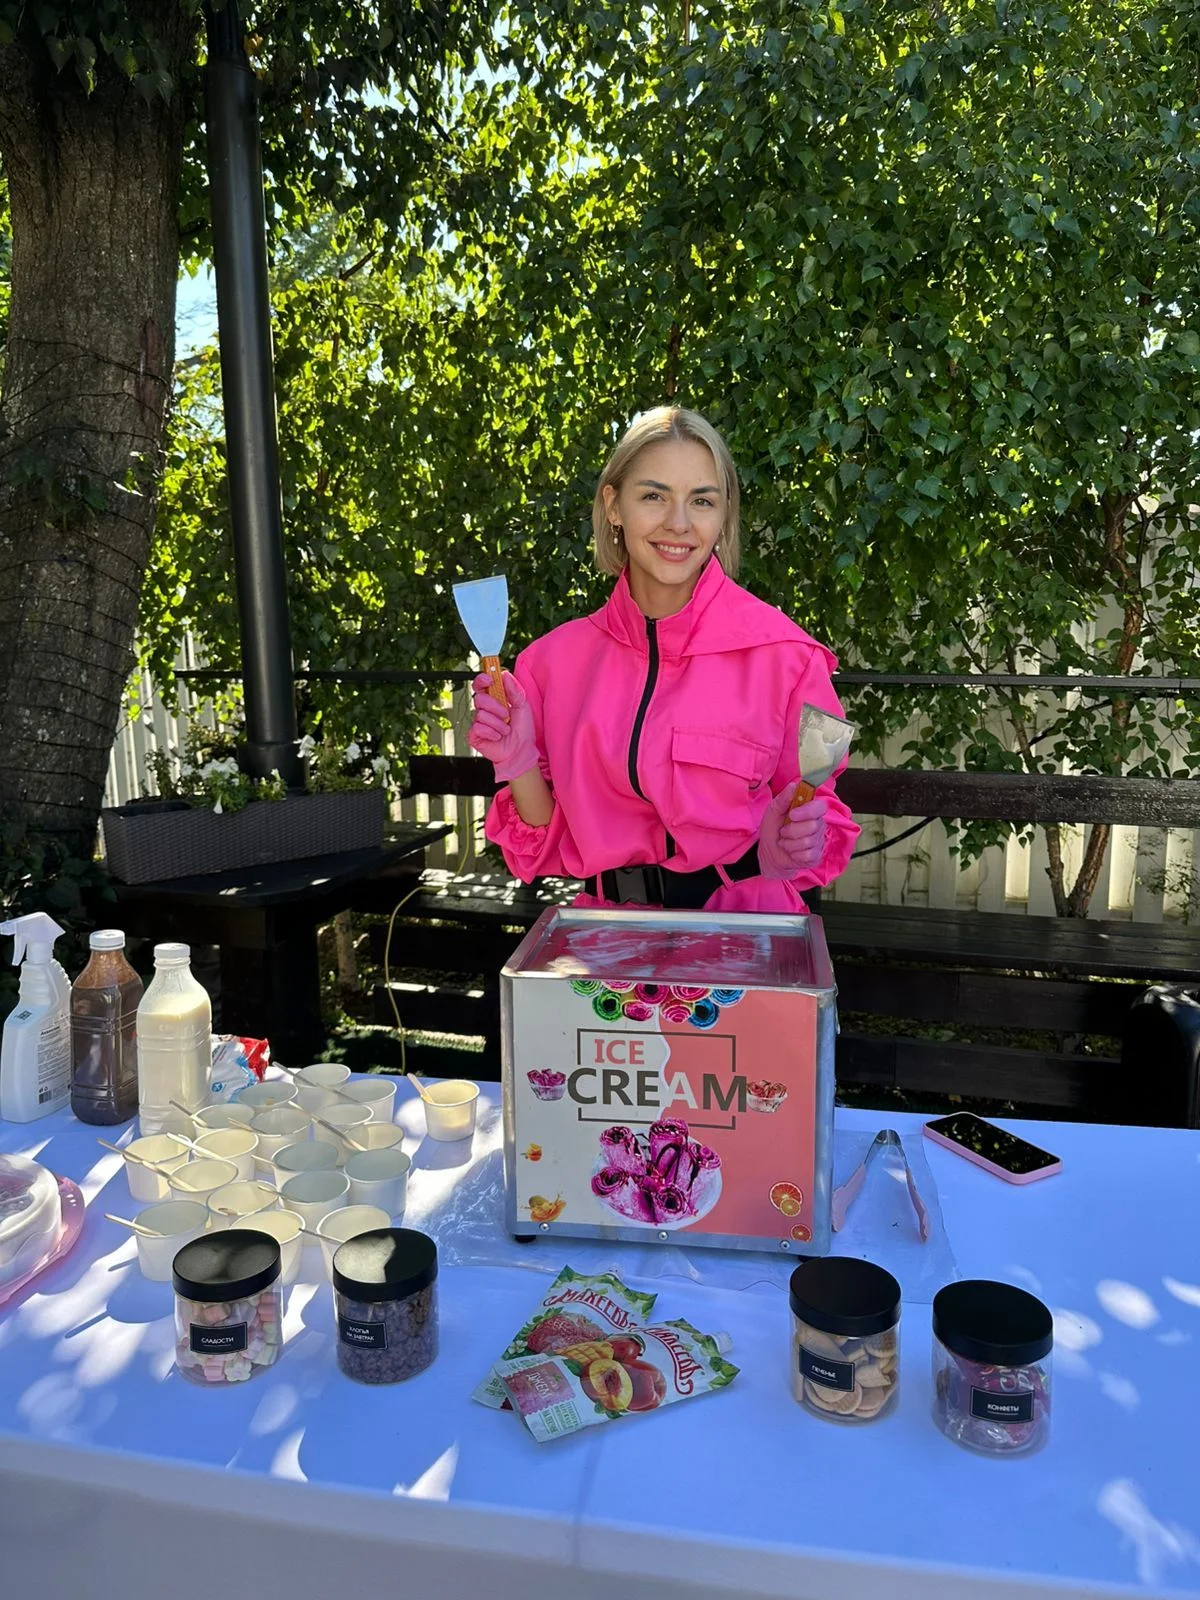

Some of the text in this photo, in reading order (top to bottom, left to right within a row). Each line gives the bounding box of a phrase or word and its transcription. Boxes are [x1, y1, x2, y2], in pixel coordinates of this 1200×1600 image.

[594, 1038, 645, 1065] ICE
[567, 1068, 747, 1113] CREAM
[201, 1336, 234, 1345] СЛАДОСТИ
[526, 1371, 553, 1399] ДЖЕМ
[987, 1403, 1020, 1412] КОНФЕТЫ
